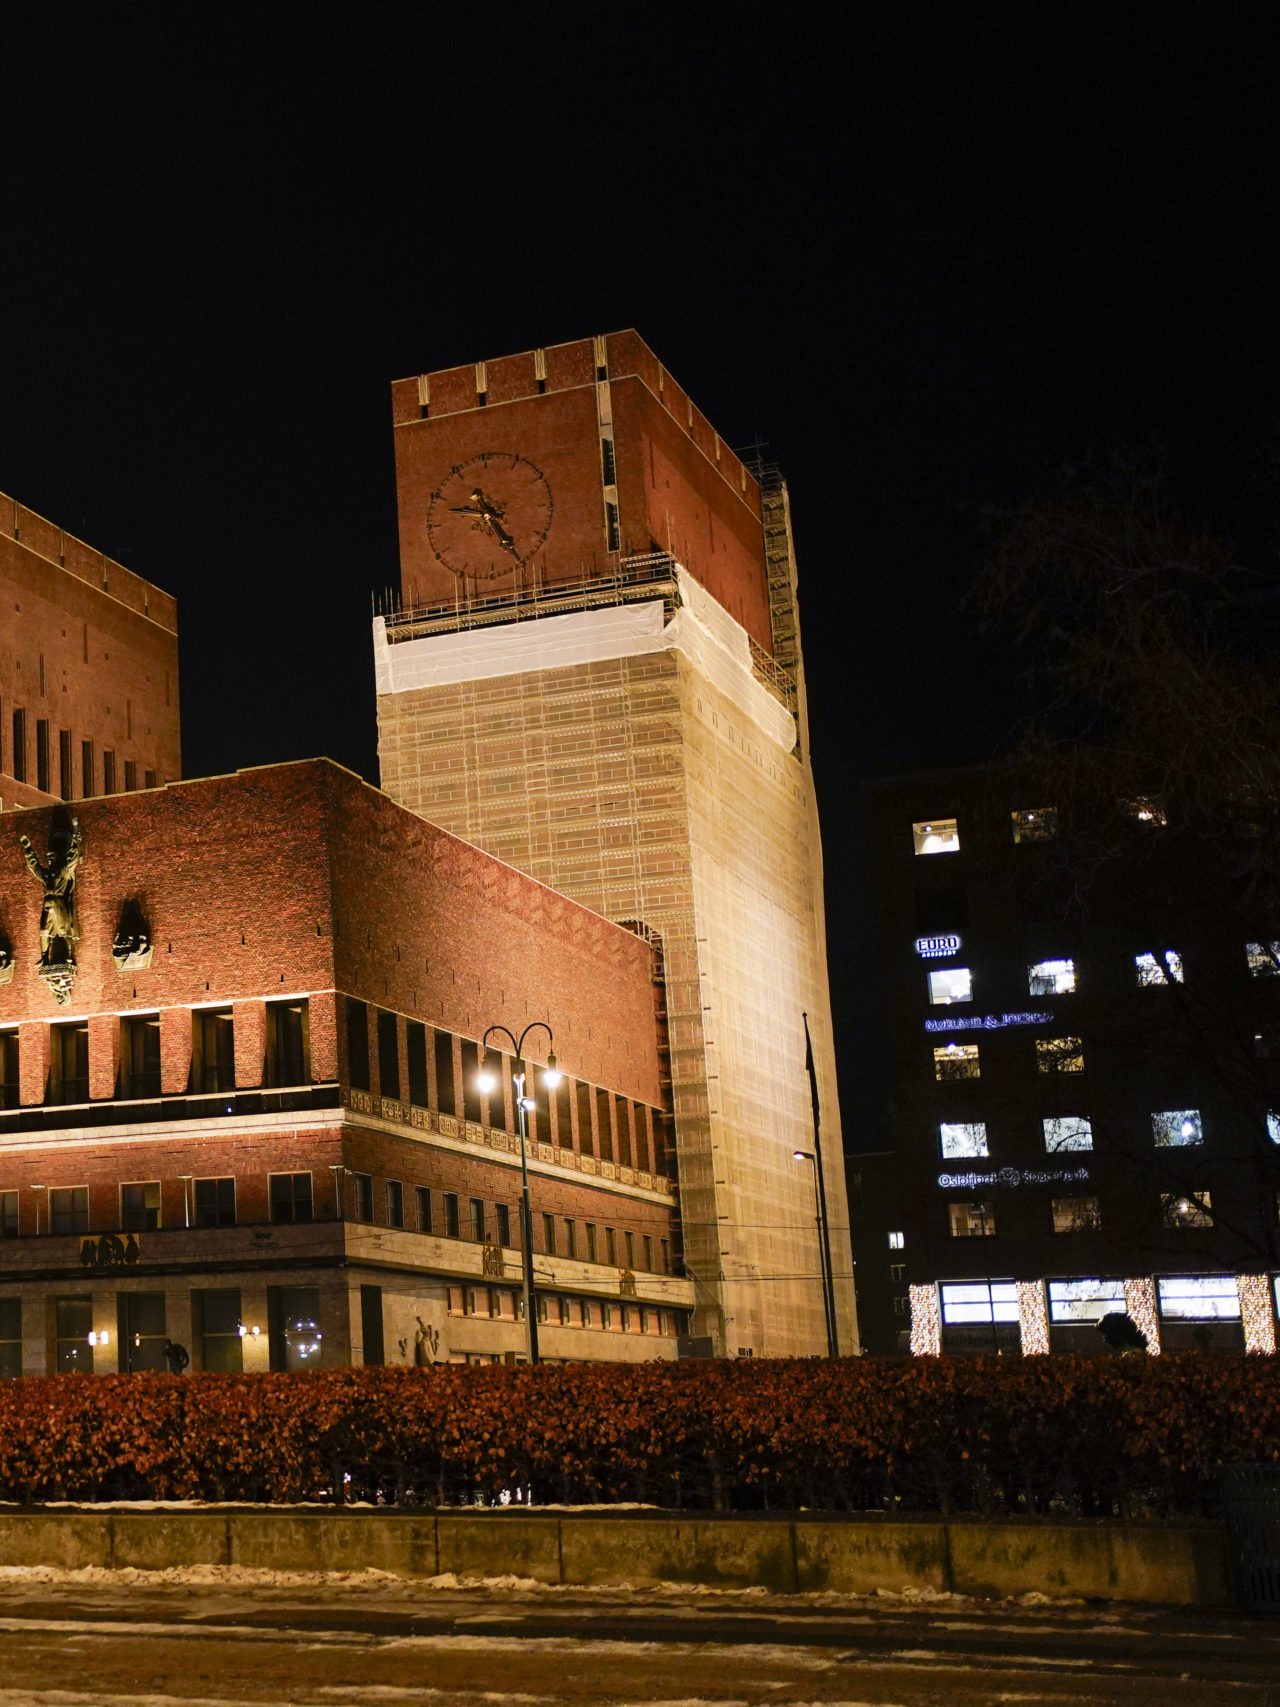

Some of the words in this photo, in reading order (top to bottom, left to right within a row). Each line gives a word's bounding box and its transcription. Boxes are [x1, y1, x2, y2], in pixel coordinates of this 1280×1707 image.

[917, 937, 958, 950] EURO
[984, 1014, 998, 1029] &
[938, 1171, 996, 1188] Oslofjord
